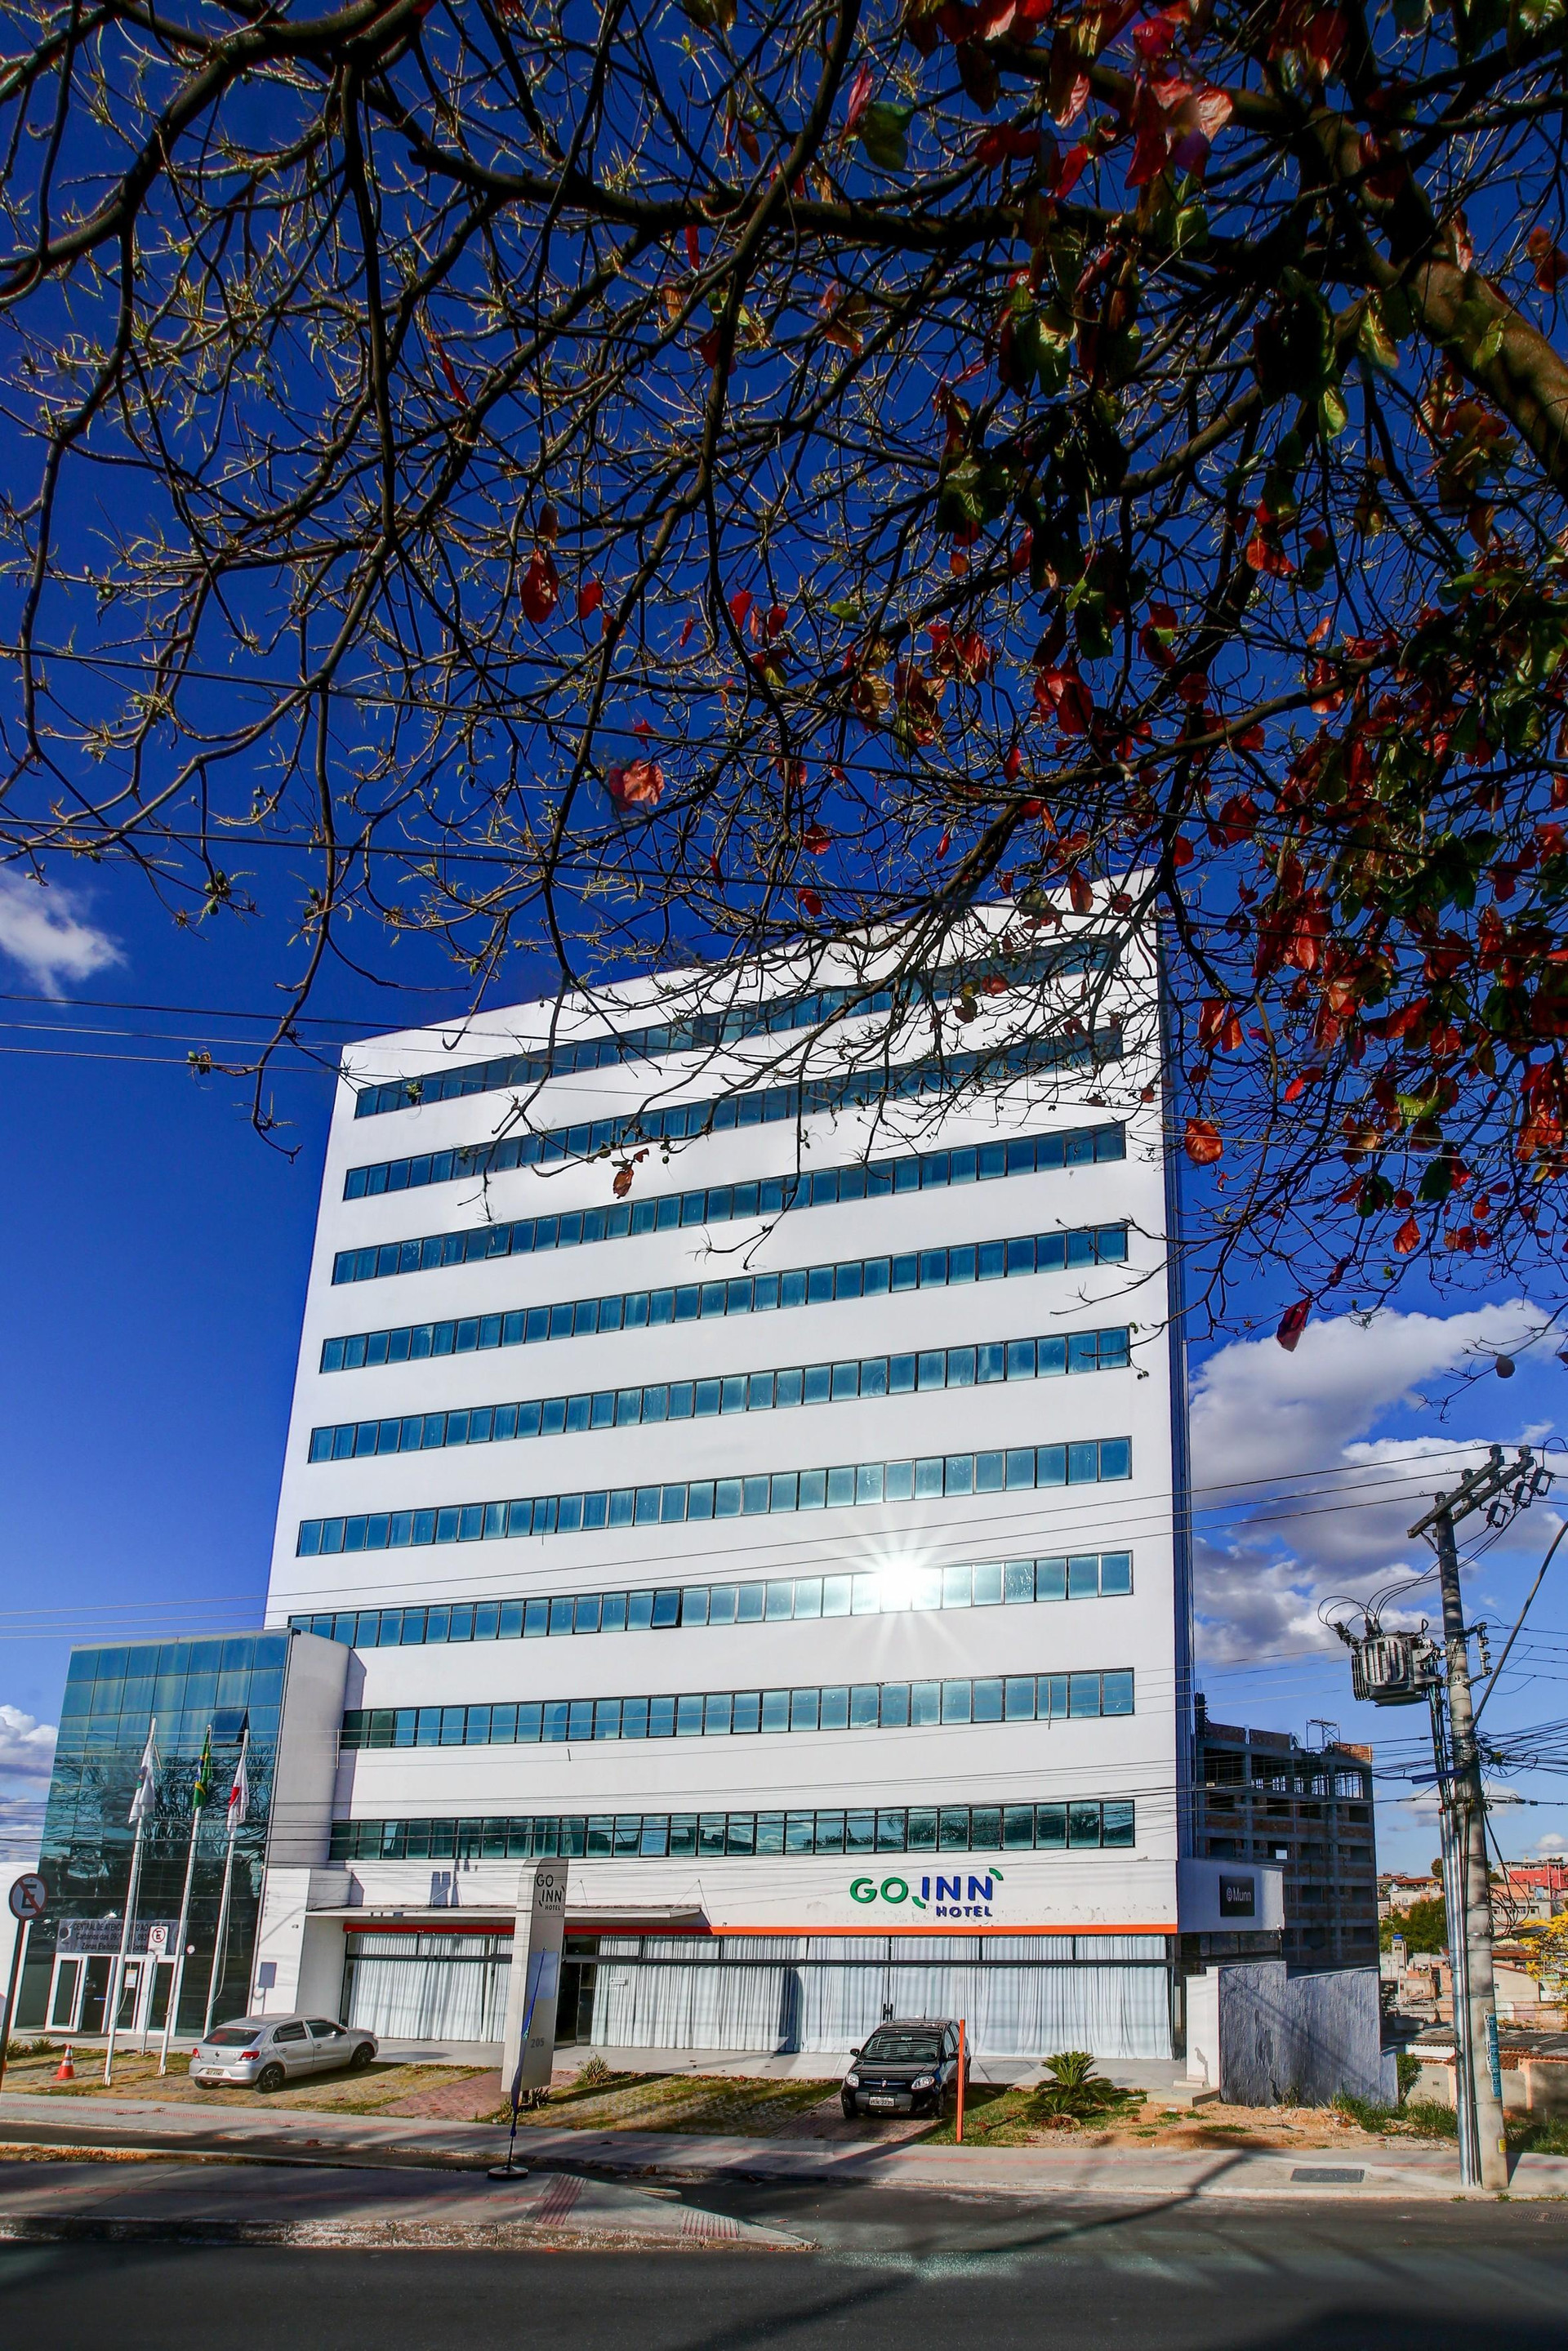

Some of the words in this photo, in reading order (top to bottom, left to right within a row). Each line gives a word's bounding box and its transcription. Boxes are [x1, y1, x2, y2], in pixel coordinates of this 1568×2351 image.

[537, 1874, 554, 1887] GO
[542, 1890, 562, 1903] INN
[850, 1877, 909, 1904] GO
[921, 1877, 993, 1901] INN
[936, 1905, 993, 1917] HOTEL
[530, 2037, 545, 2048] 205
